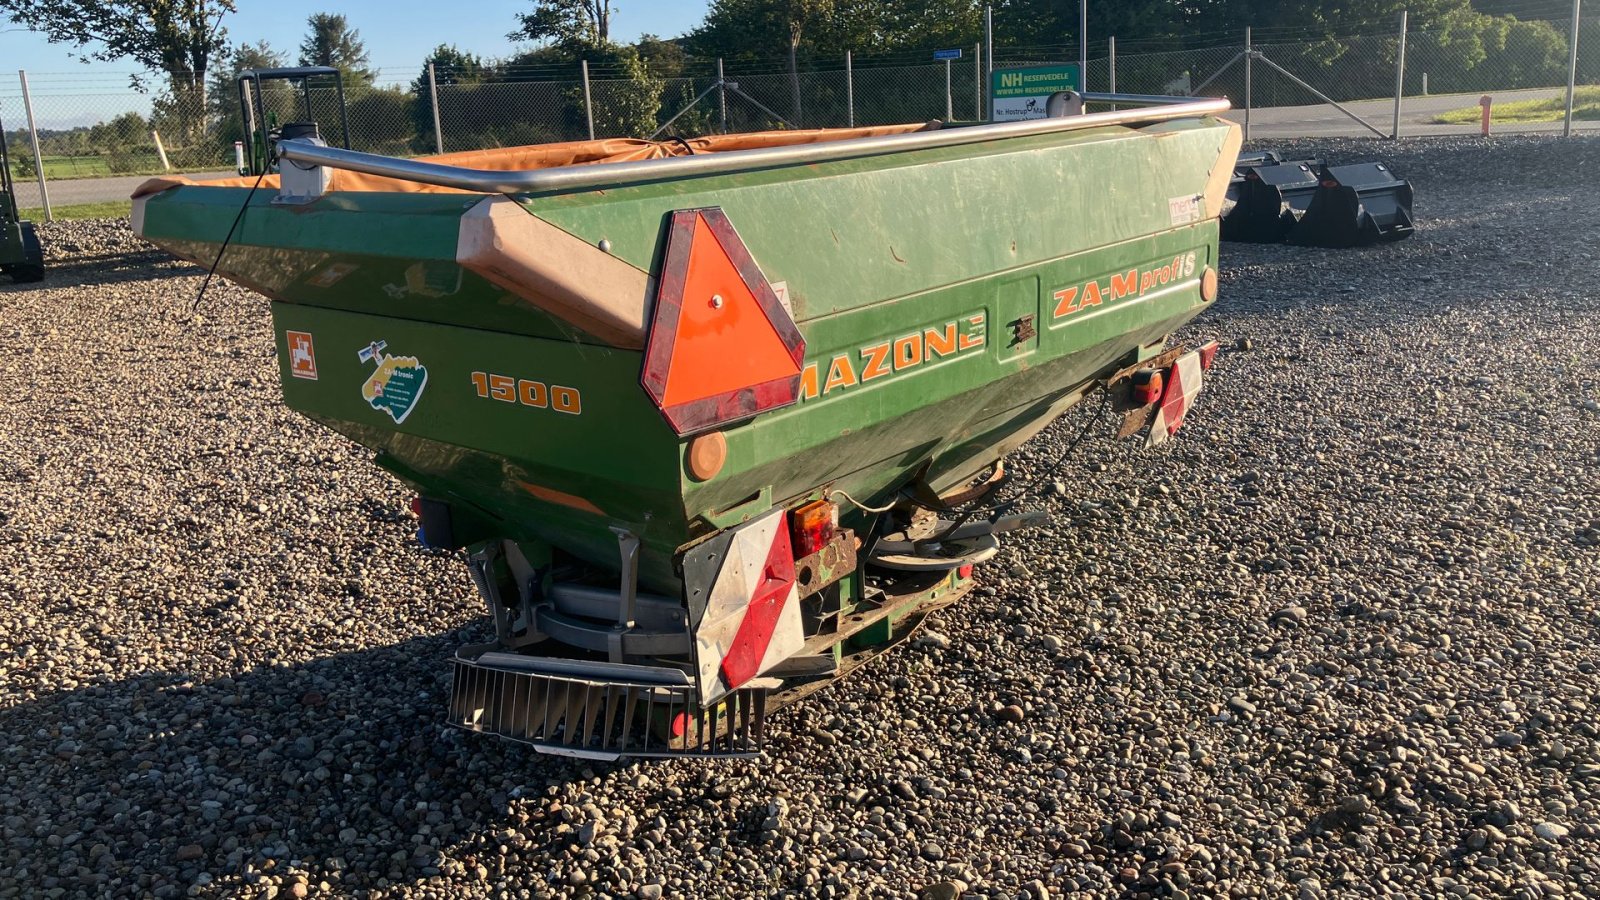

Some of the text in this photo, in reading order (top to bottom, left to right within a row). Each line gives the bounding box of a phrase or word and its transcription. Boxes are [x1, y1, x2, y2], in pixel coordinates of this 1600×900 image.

[1001, 73, 1069, 87] NH RESERVEDELE
[1054, 269, 1138, 318] ZA-M
[798, 314, 984, 400] MAZONE
[471, 371, 582, 415] 1500
